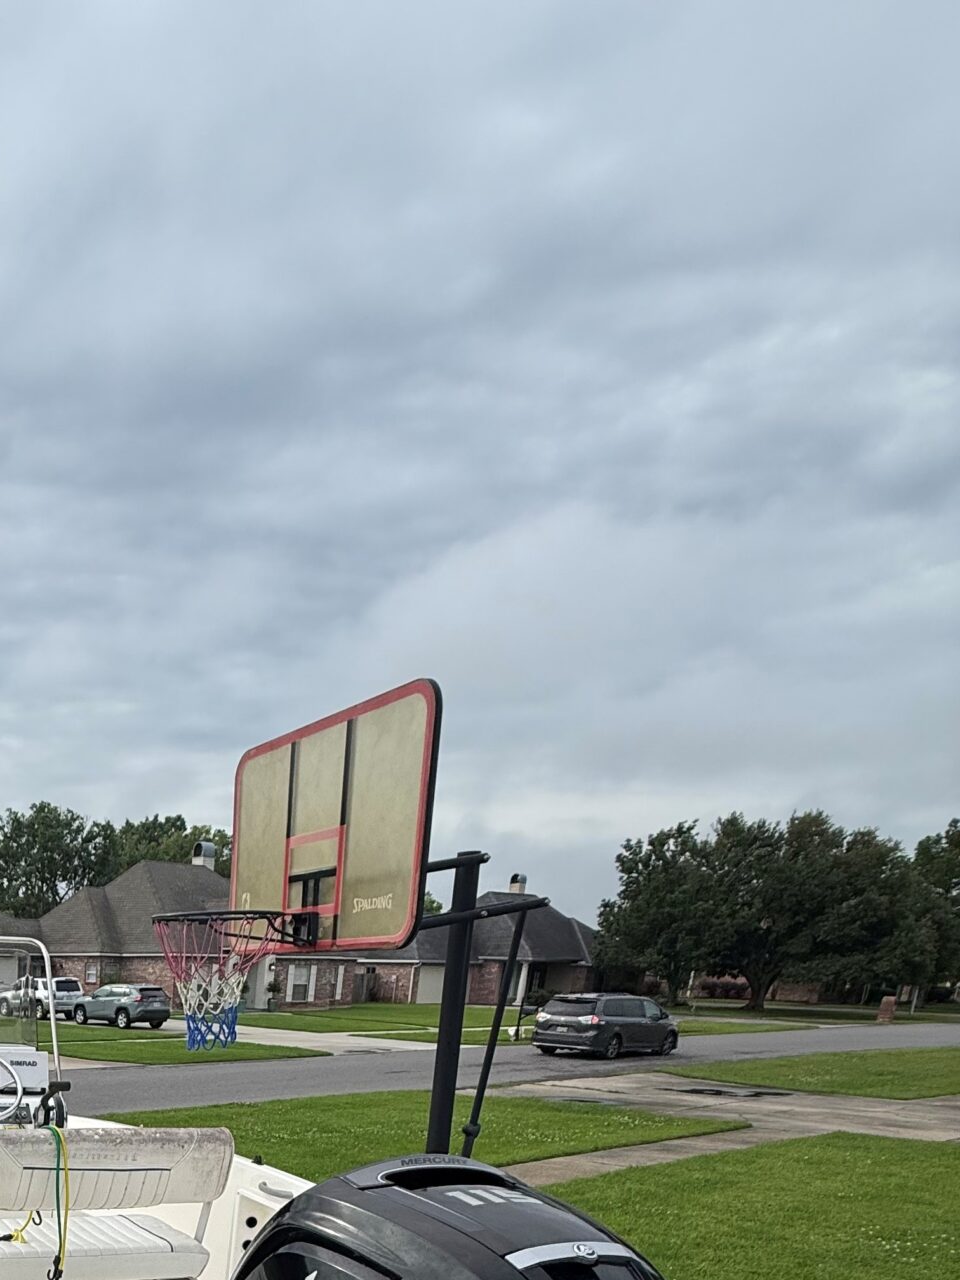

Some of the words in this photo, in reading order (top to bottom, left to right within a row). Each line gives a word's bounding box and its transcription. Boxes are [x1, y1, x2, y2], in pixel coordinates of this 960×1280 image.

[352, 893, 393, 914] SPALDING
[400, 1156, 468, 1167] MERCURY
[445, 1189, 543, 1206] 115
